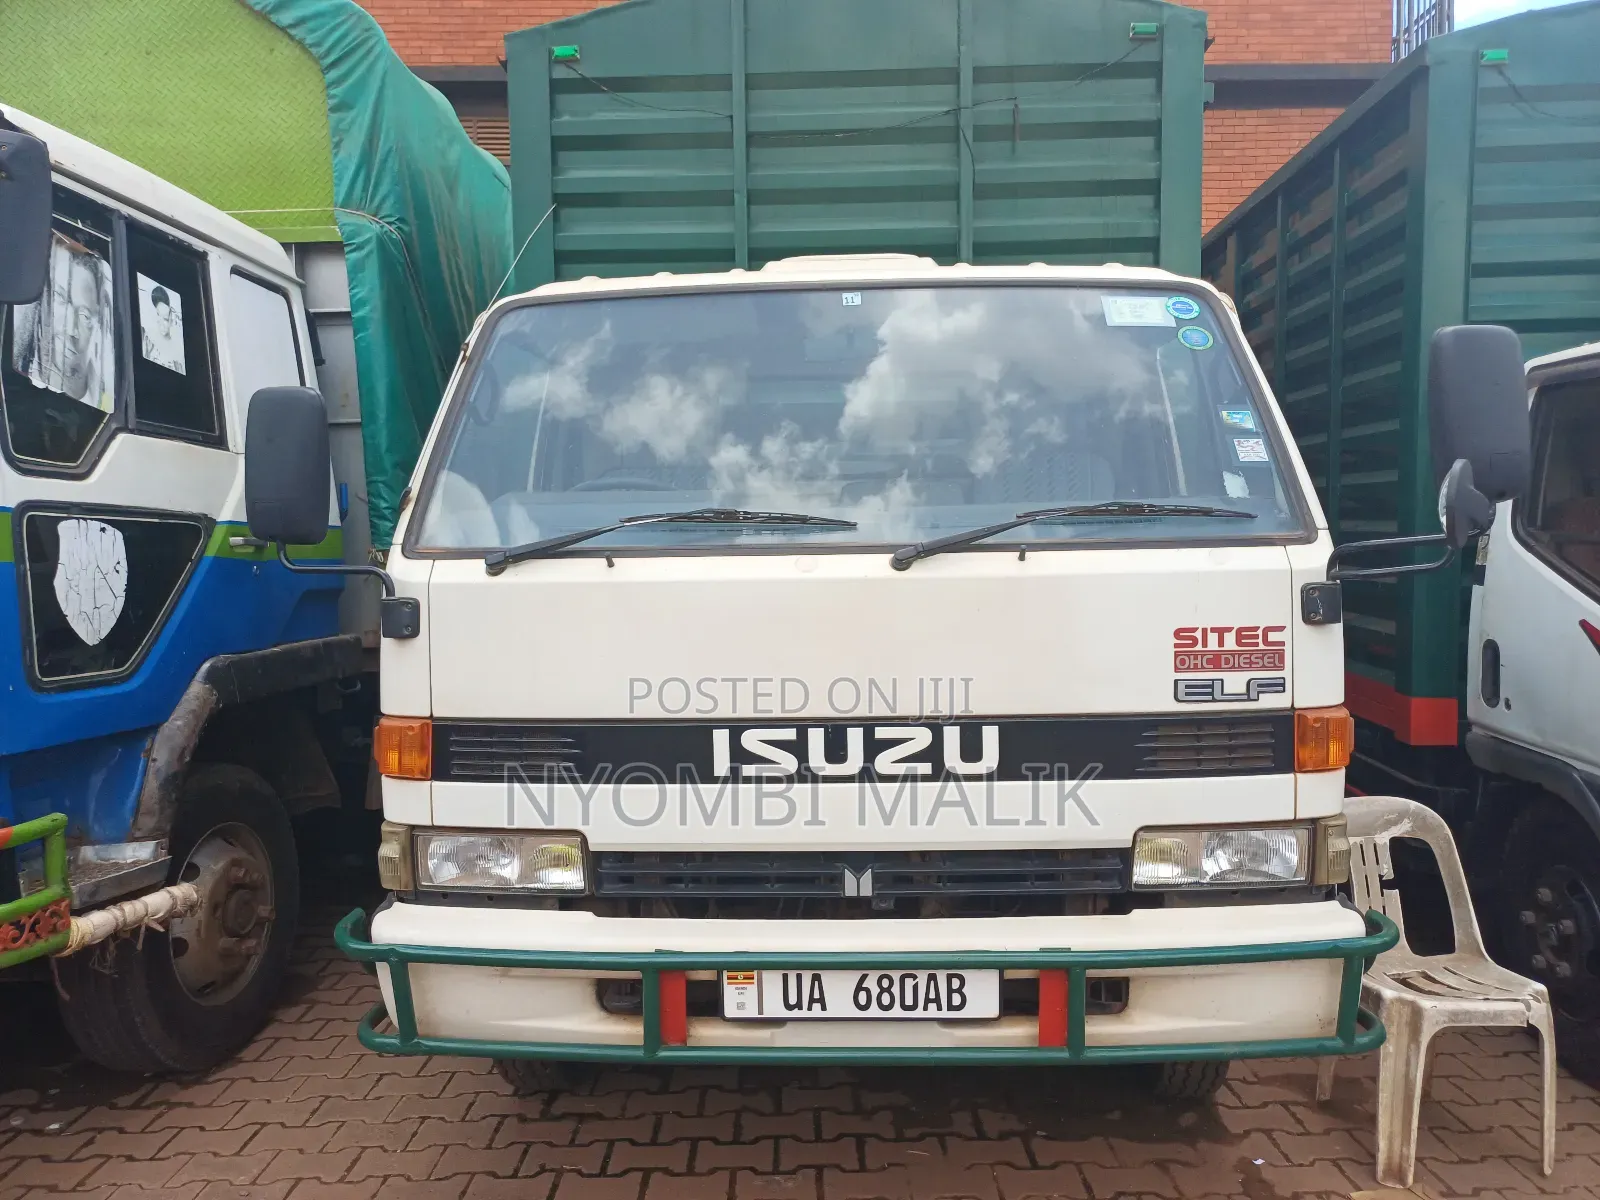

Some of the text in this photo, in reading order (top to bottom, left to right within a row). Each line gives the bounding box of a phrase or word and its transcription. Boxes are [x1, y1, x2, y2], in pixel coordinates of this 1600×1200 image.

[1173, 625, 1287, 649] SITEC
[1175, 653, 1284, 669] OHC DIESEL
[1173, 677, 1286, 703] ELF
[712, 725, 1000, 777] ISUZU
[781, 972, 968, 1012] UA 680AB
